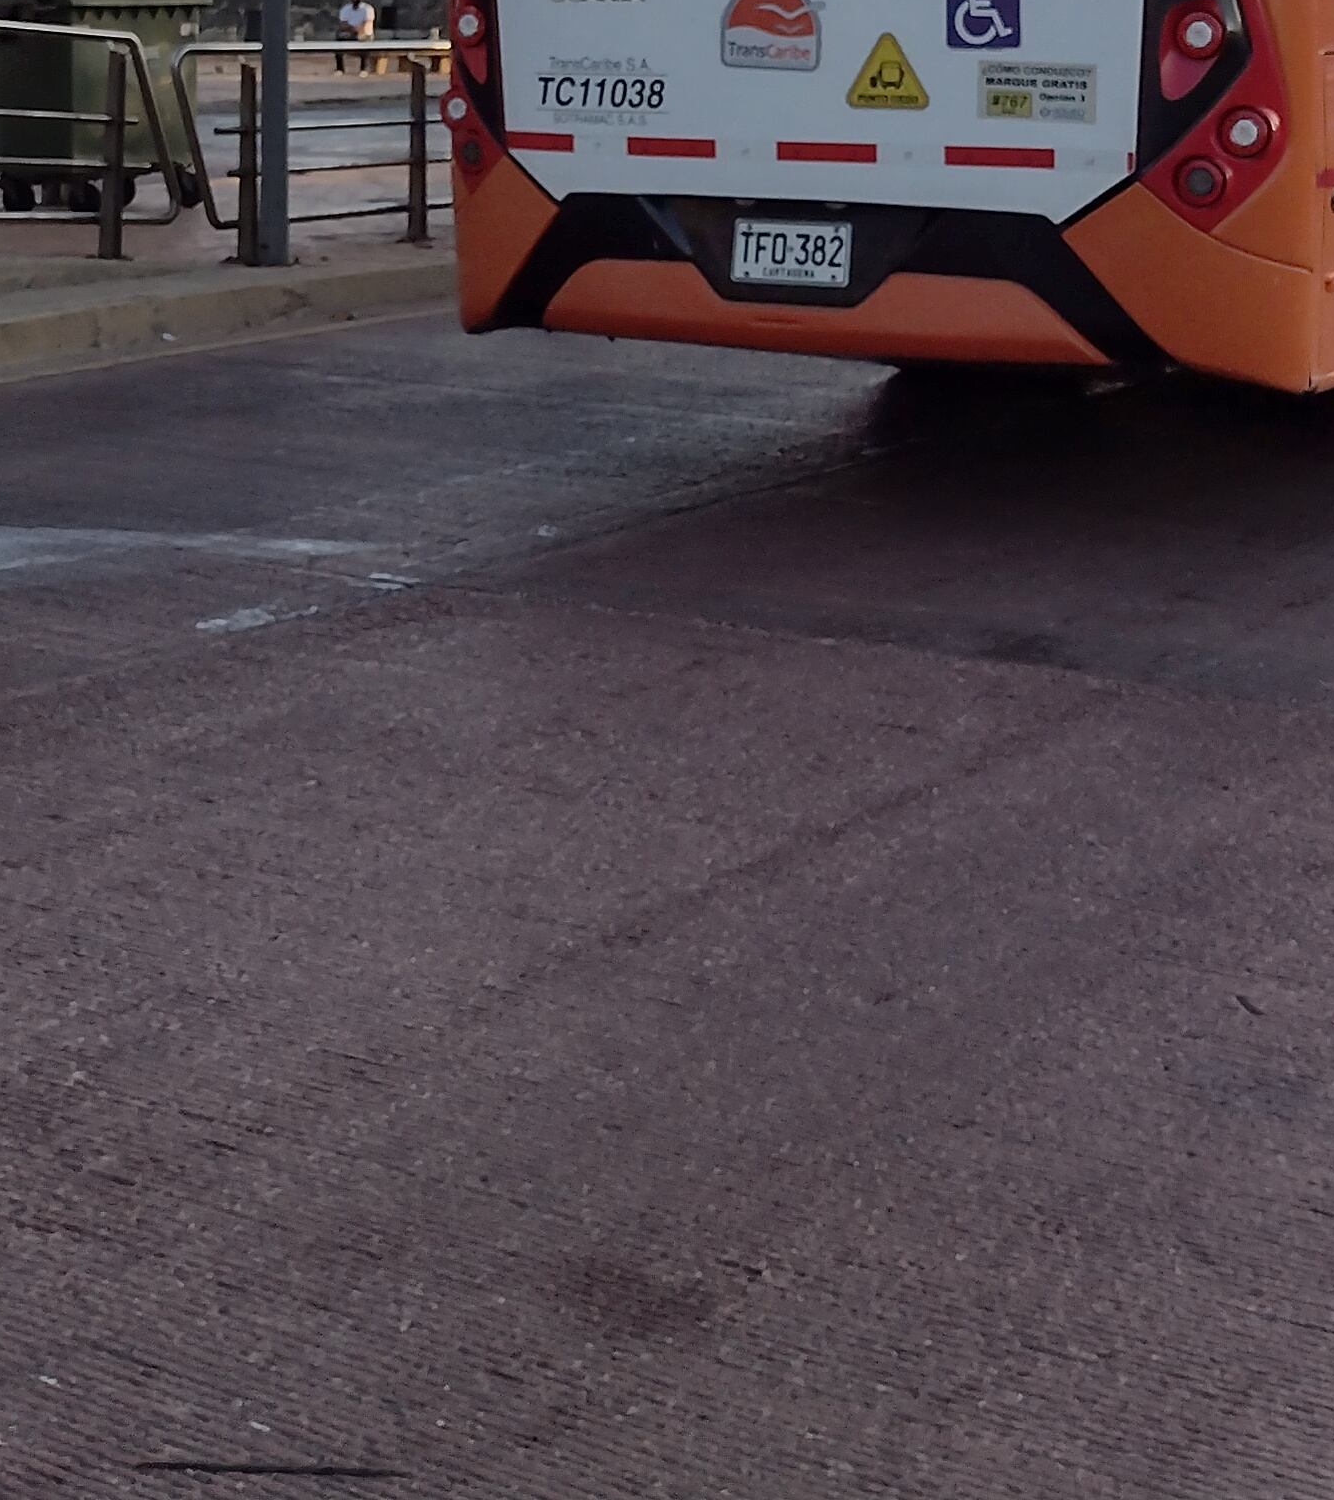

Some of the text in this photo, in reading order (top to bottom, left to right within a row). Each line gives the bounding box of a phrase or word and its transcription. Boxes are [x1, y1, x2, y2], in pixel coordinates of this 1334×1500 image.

[727, 40, 812, 61] TransCaribe
[538, 76, 665, 109] TC11038
[1042, 80, 1087, 90] GRATIS
